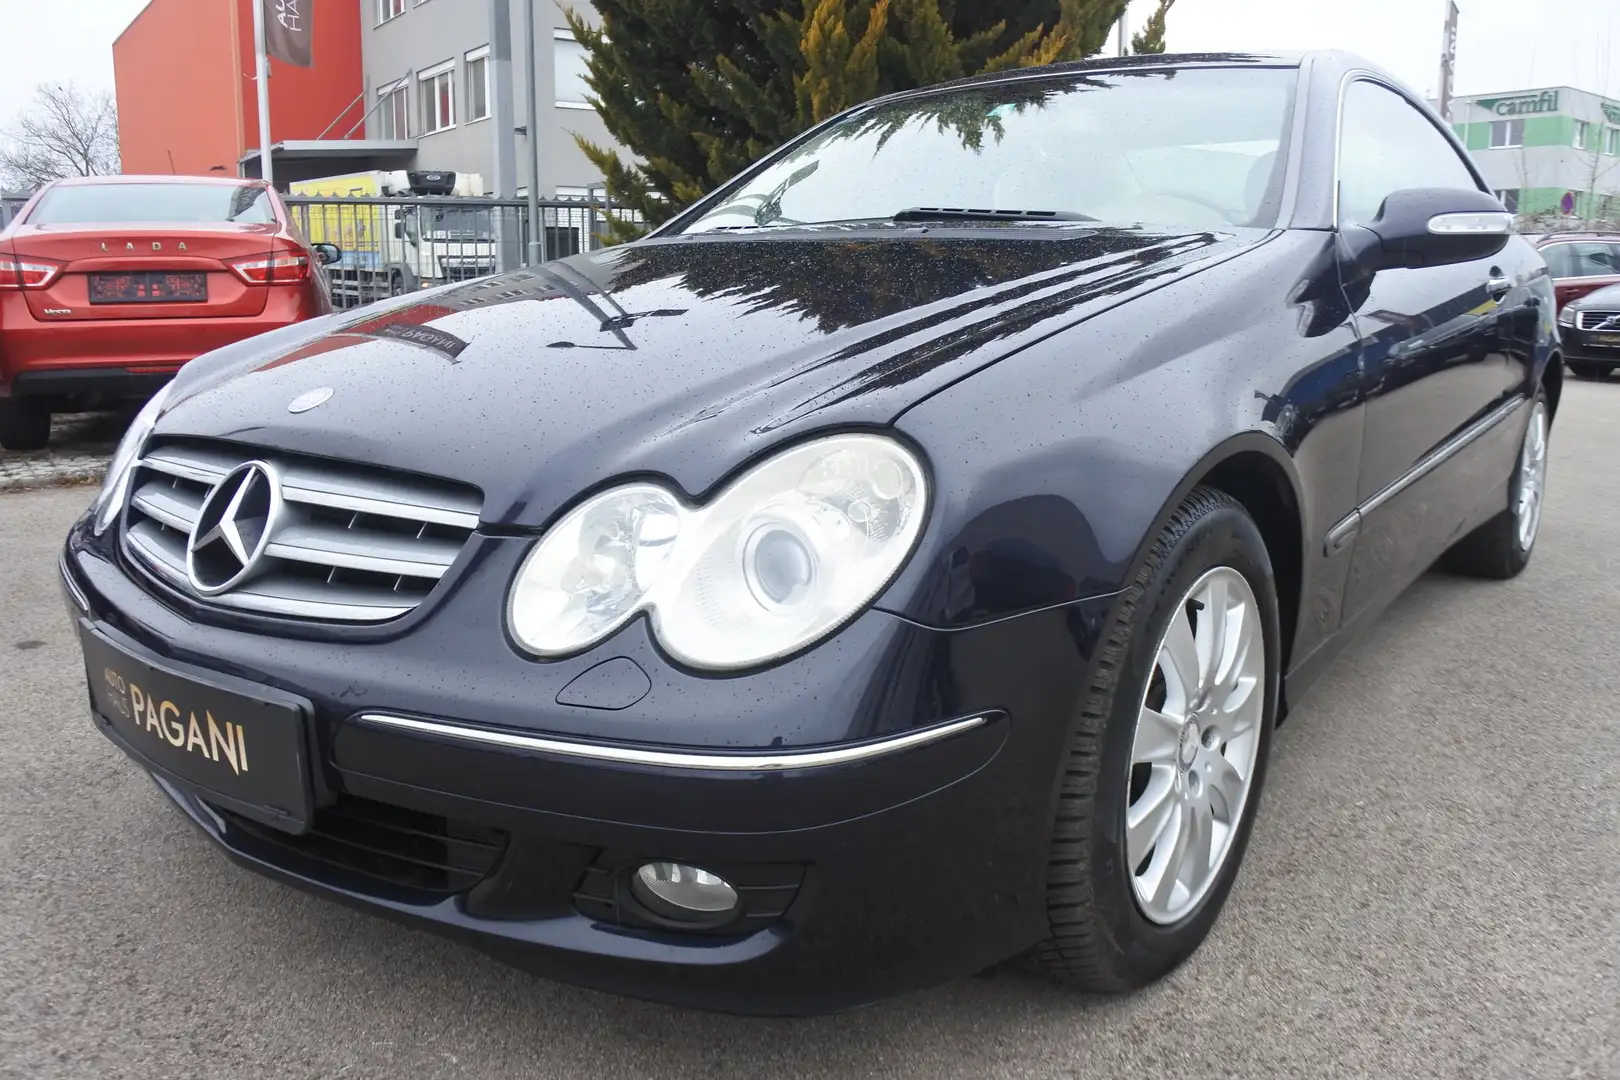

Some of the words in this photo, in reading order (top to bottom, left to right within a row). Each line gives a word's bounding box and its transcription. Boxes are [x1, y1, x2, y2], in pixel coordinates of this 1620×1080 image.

[1496, 90, 1558, 115] camfil
[101, 242, 187, 251] LADA
[104, 668, 126, 695] AUTO
[129, 683, 249, 776] PAGANI
